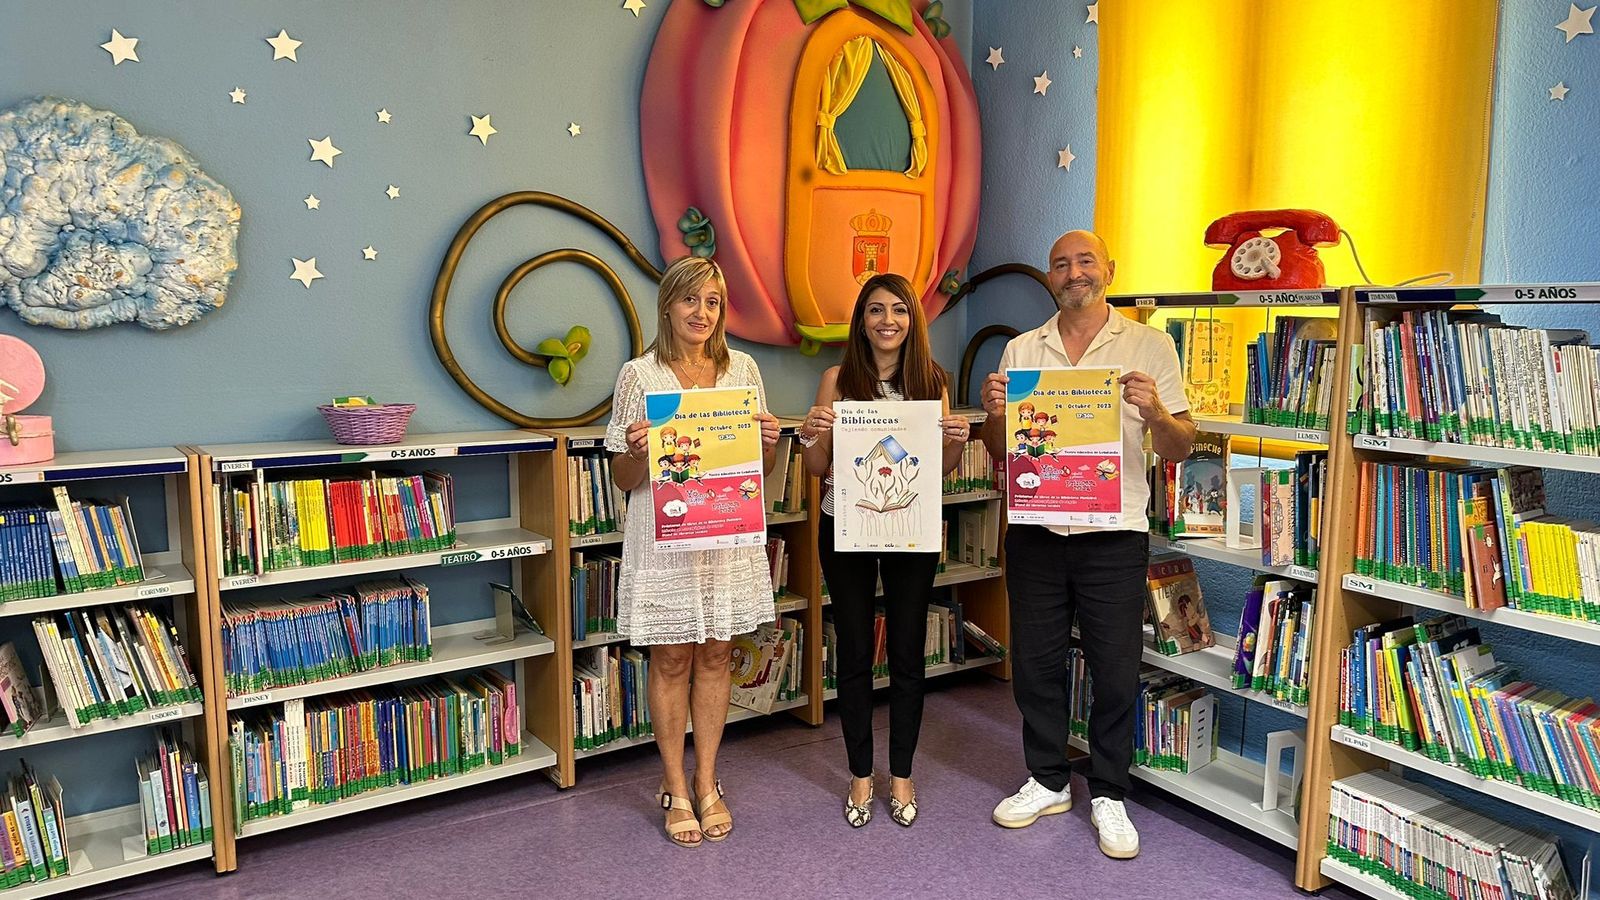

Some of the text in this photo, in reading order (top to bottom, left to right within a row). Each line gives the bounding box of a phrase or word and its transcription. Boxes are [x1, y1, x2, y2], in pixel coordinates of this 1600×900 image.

[1275, 292, 1298, 303] AÑO
[1515, 286, 1576, 299] 0-5 AÑOS
[1363, 438, 1388, 447] SM
[391, 450, 406, 458] 0-5
[442, 553, 477, 565] TEATRO
[507, 545, 532, 556] AÑOS
[232, 578, 257, 586] EVEREST
[1350, 580, 1373, 590] SM
[140, 586, 170, 596] CORIMBO
[244, 694, 270, 704] DISNEY
[152, 710, 180, 720] USBORNE
